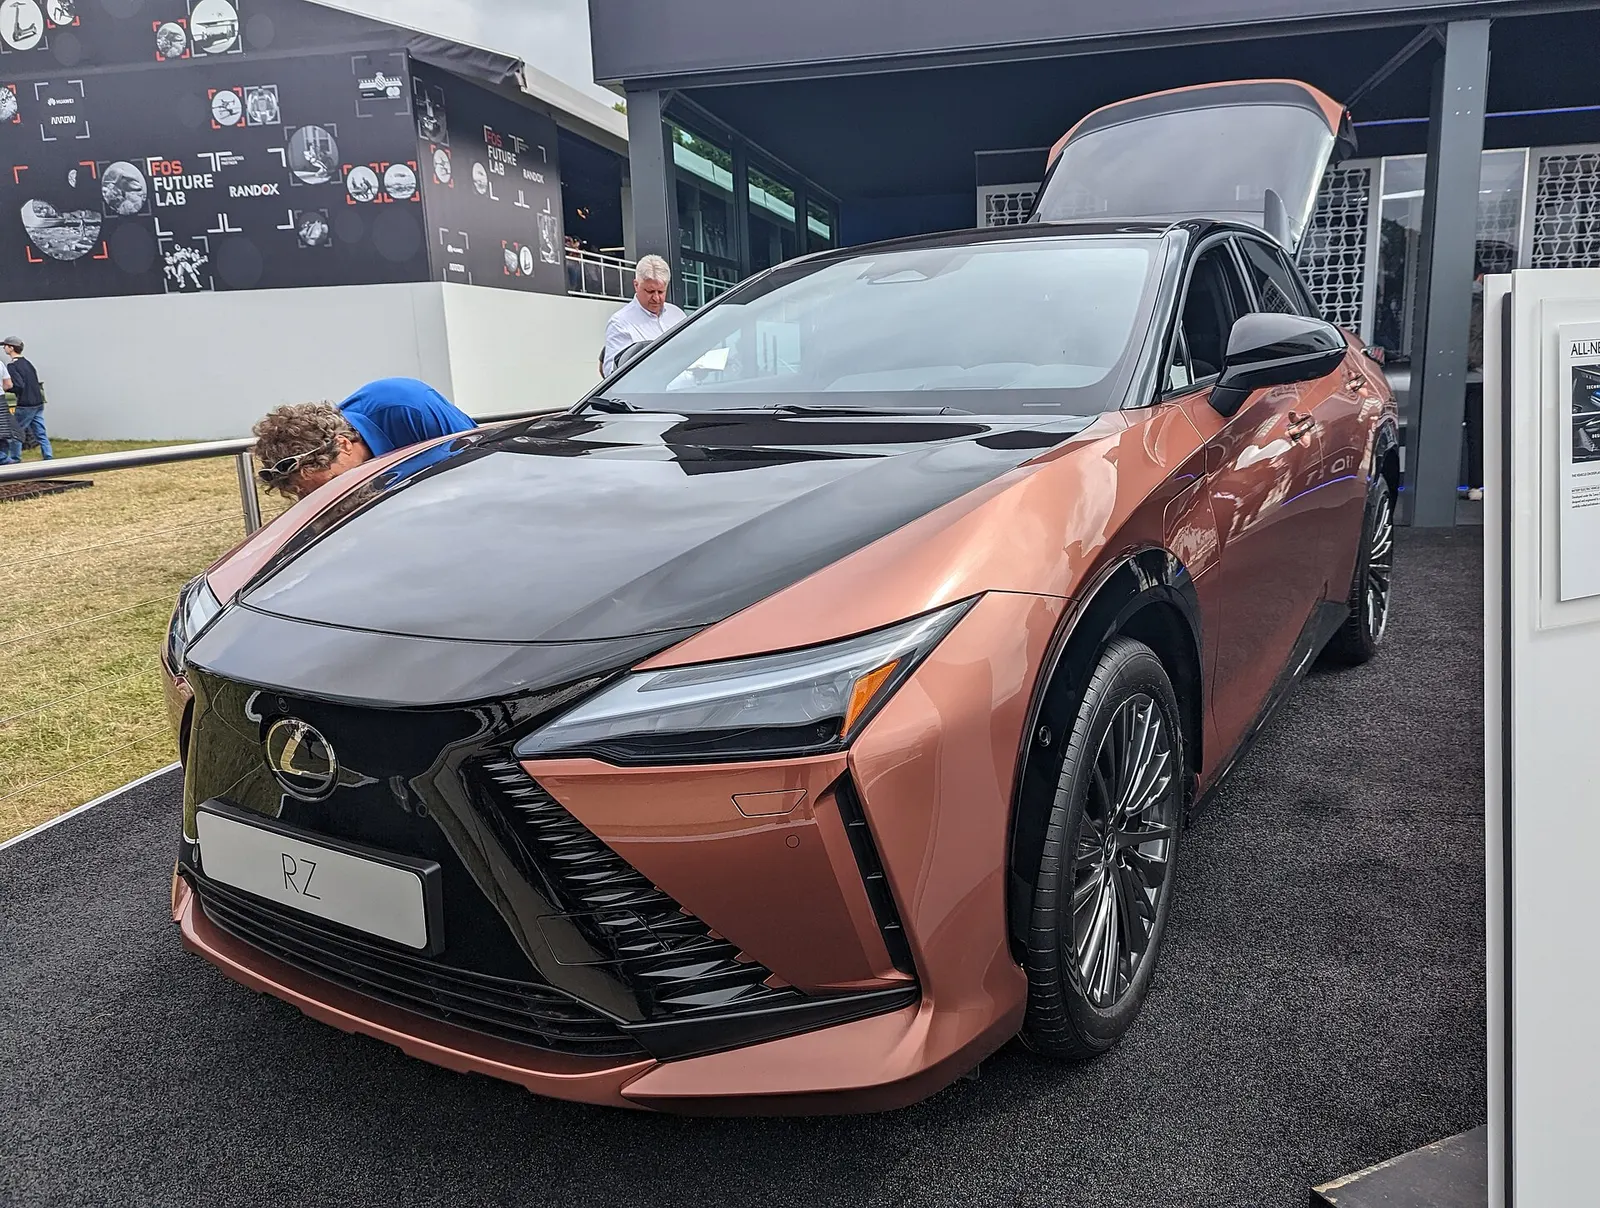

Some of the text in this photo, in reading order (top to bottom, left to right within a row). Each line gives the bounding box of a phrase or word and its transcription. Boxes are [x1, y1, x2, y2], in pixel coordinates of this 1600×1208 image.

[487, 130, 502, 147] FOS
[488, 145, 517, 166] FUTURE
[152, 160, 183, 177] FOS
[489, 159, 505, 175] LAB
[153, 174, 214, 191] FUTURE
[523, 168, 545, 184] RANDOX
[155, 191, 187, 206] LAB
[229, 183, 280, 197] RANDOX
[281, 852, 321, 900] RZ
